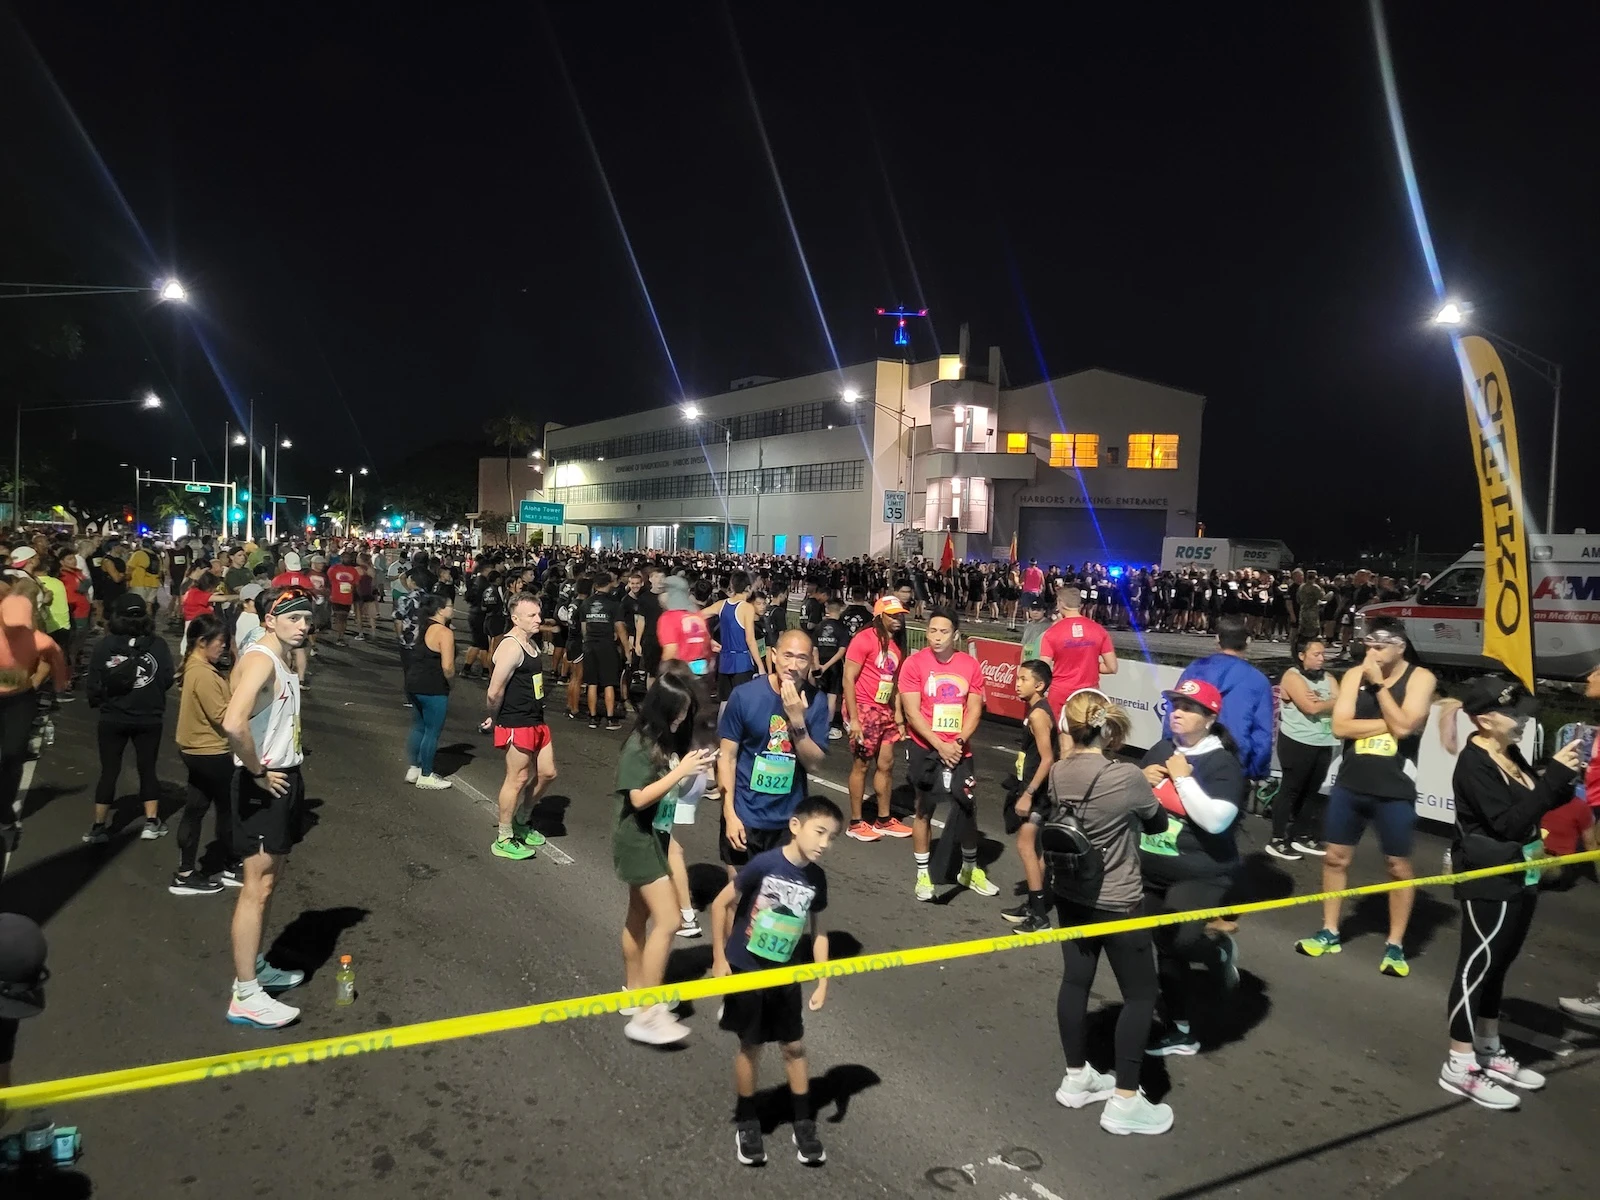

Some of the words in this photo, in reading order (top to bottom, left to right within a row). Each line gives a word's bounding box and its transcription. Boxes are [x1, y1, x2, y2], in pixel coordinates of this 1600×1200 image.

[1020, 495, 1065, 504] HARBORS
[1069, 496, 1111, 505] PARKING
[1116, 496, 1168, 506] ENTRANCE
[1473, 371, 1521, 636] SEIKO
[886, 507, 902, 519] 35
[1401, 608, 1412, 616] 84
[1548, 611, 1589, 620] Medical
[937, 718, 959, 728] 1126
[1361, 738, 1391, 751] 1075
[756, 773, 789, 789] 8322
